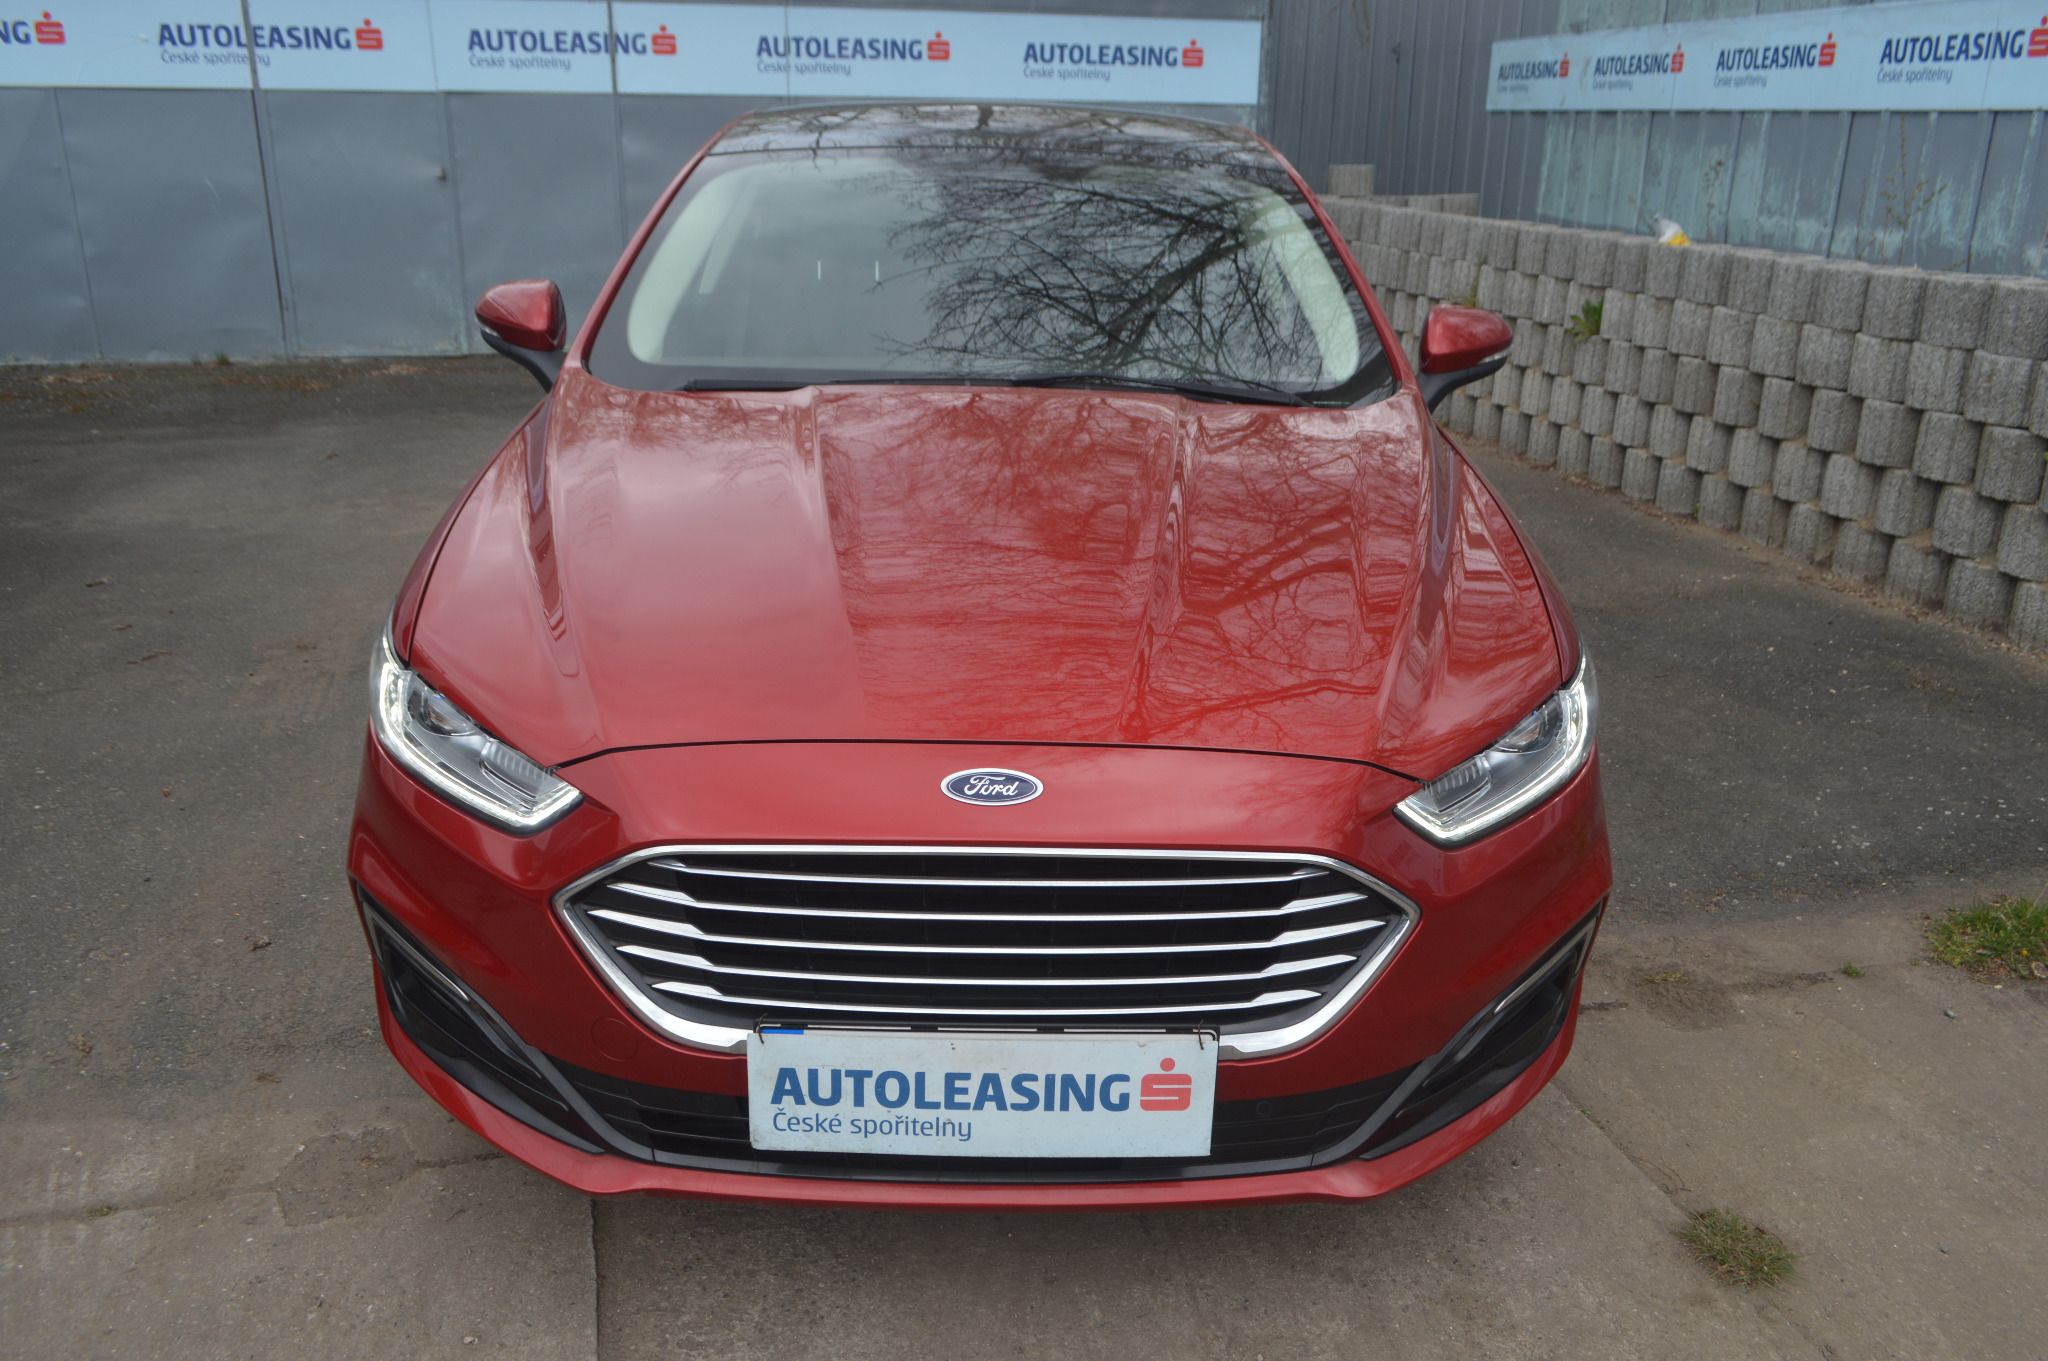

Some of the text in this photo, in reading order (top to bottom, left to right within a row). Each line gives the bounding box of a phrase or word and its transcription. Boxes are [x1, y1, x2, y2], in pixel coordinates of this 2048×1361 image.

[159, 23, 352, 51] AUTOLEASING
[468, 29, 648, 55] AUTOLEASING
[756, 36, 923, 61] AUTOLEASING
[1879, 29, 2026, 65] AUTOLEASING
[1023, 42, 1178, 67] AUTOLEASING
[1594, 53, 1670, 77] AUTOLEASING
[1716, 43, 1818, 72] AUTOLEASING
[1498, 60, 1560, 82] AUTOLEASING
[963, 775, 1020, 796] Ford
[770, 1067, 1131, 1112] AUTOLEASING
[773, 1107, 972, 1141] České spořitelny
